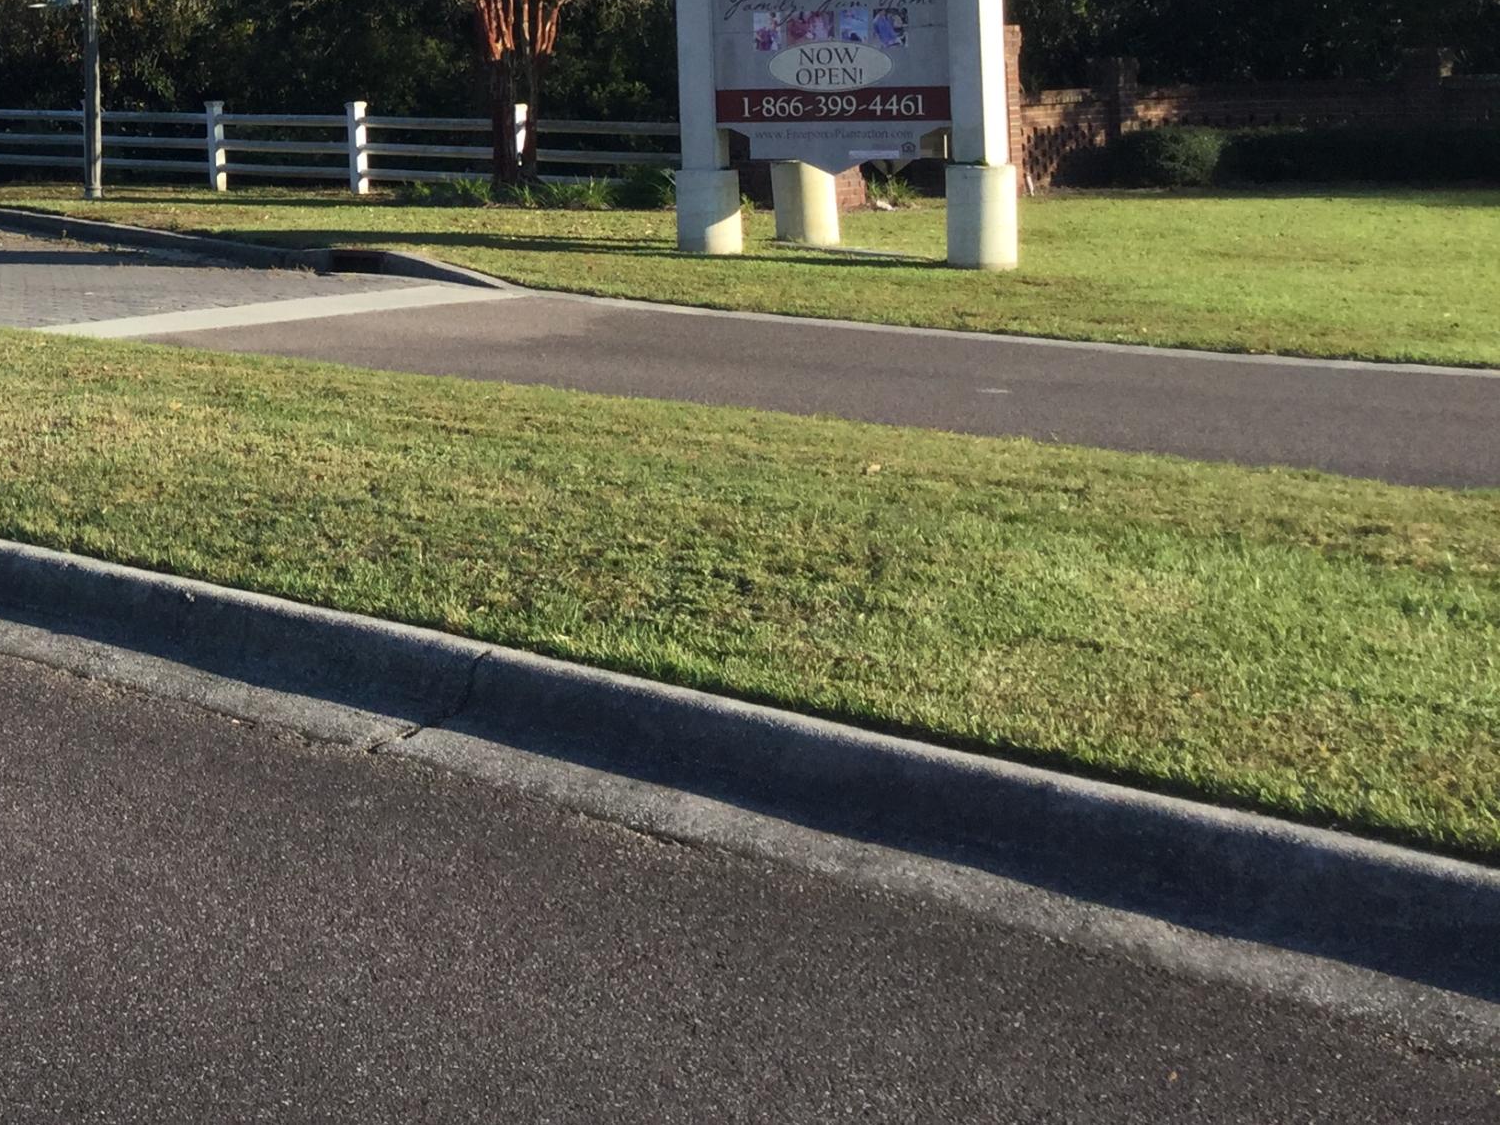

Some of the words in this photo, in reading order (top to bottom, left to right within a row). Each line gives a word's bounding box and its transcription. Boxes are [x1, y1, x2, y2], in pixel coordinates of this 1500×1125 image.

[799, 47, 861, 65] NOW
[795, 67, 864, 86] OPEN!
[741, 94, 926, 118] 1-866-399-4461
